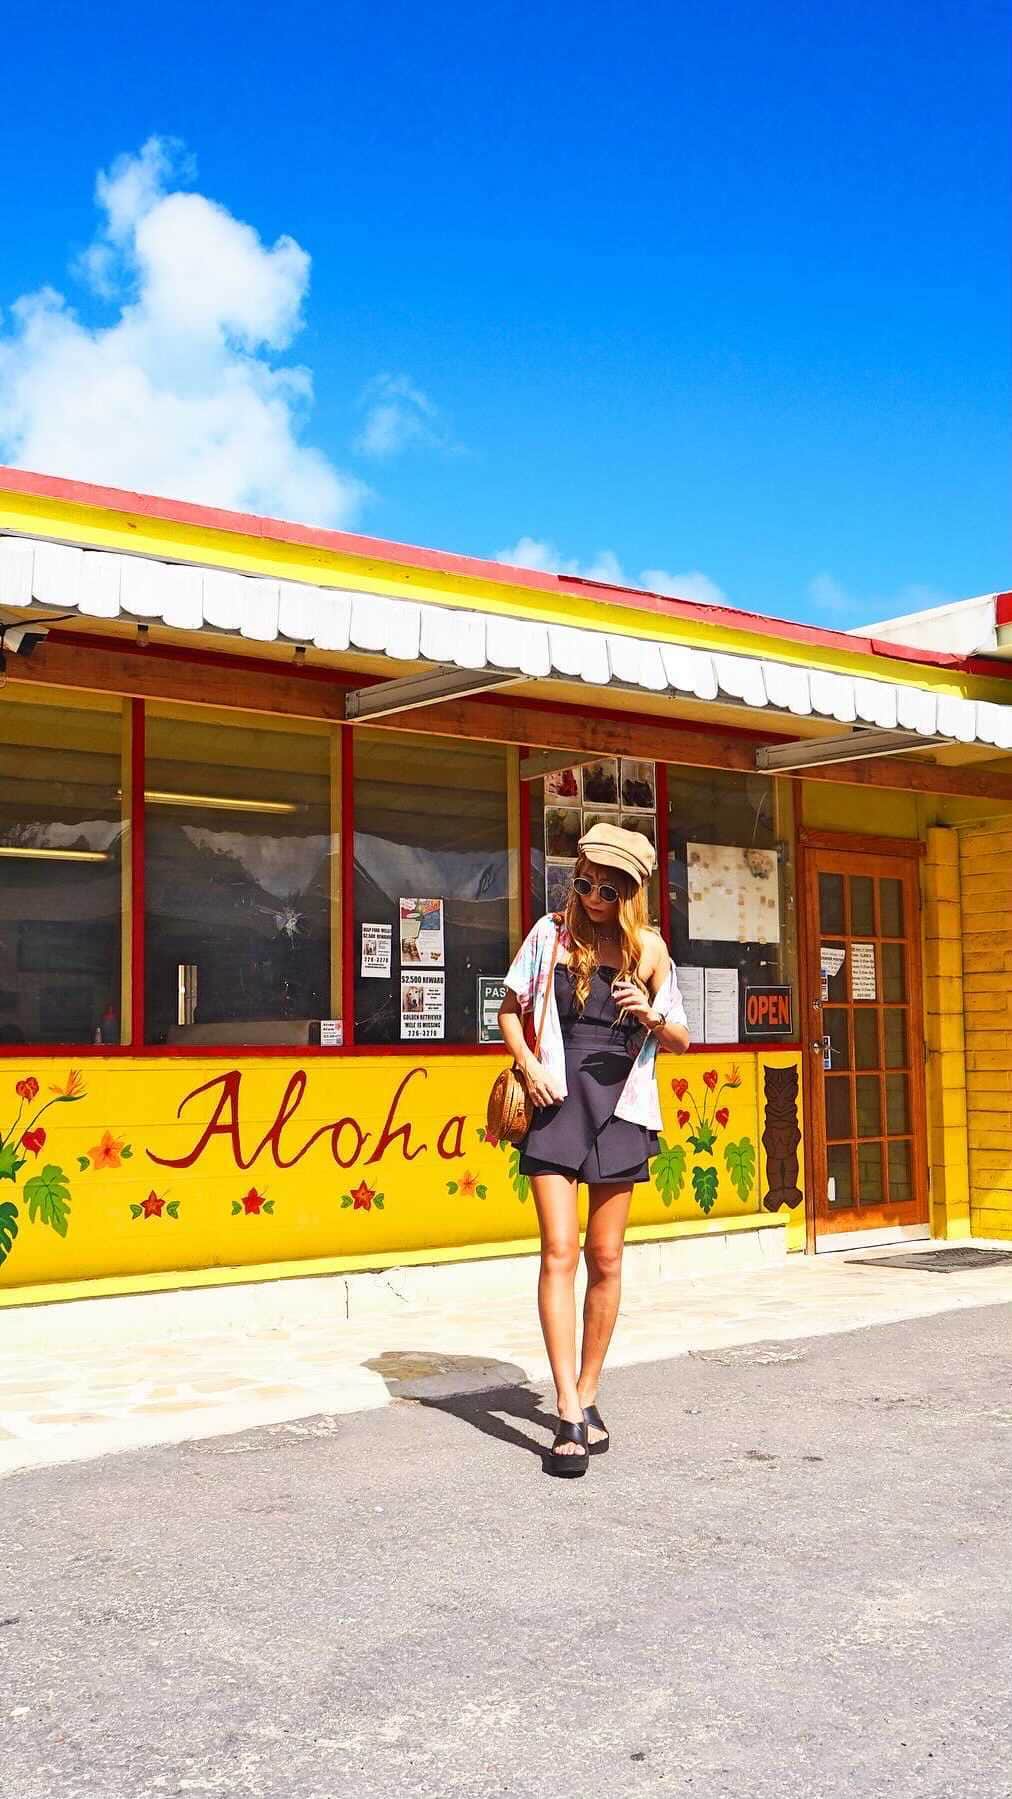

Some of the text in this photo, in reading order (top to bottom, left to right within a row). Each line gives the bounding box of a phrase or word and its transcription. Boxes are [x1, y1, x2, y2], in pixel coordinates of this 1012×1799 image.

[422, 976, 444, 984] REWARD
[747, 995, 789, 1025] OPEN
[145, 1068, 467, 1170] Aloha
